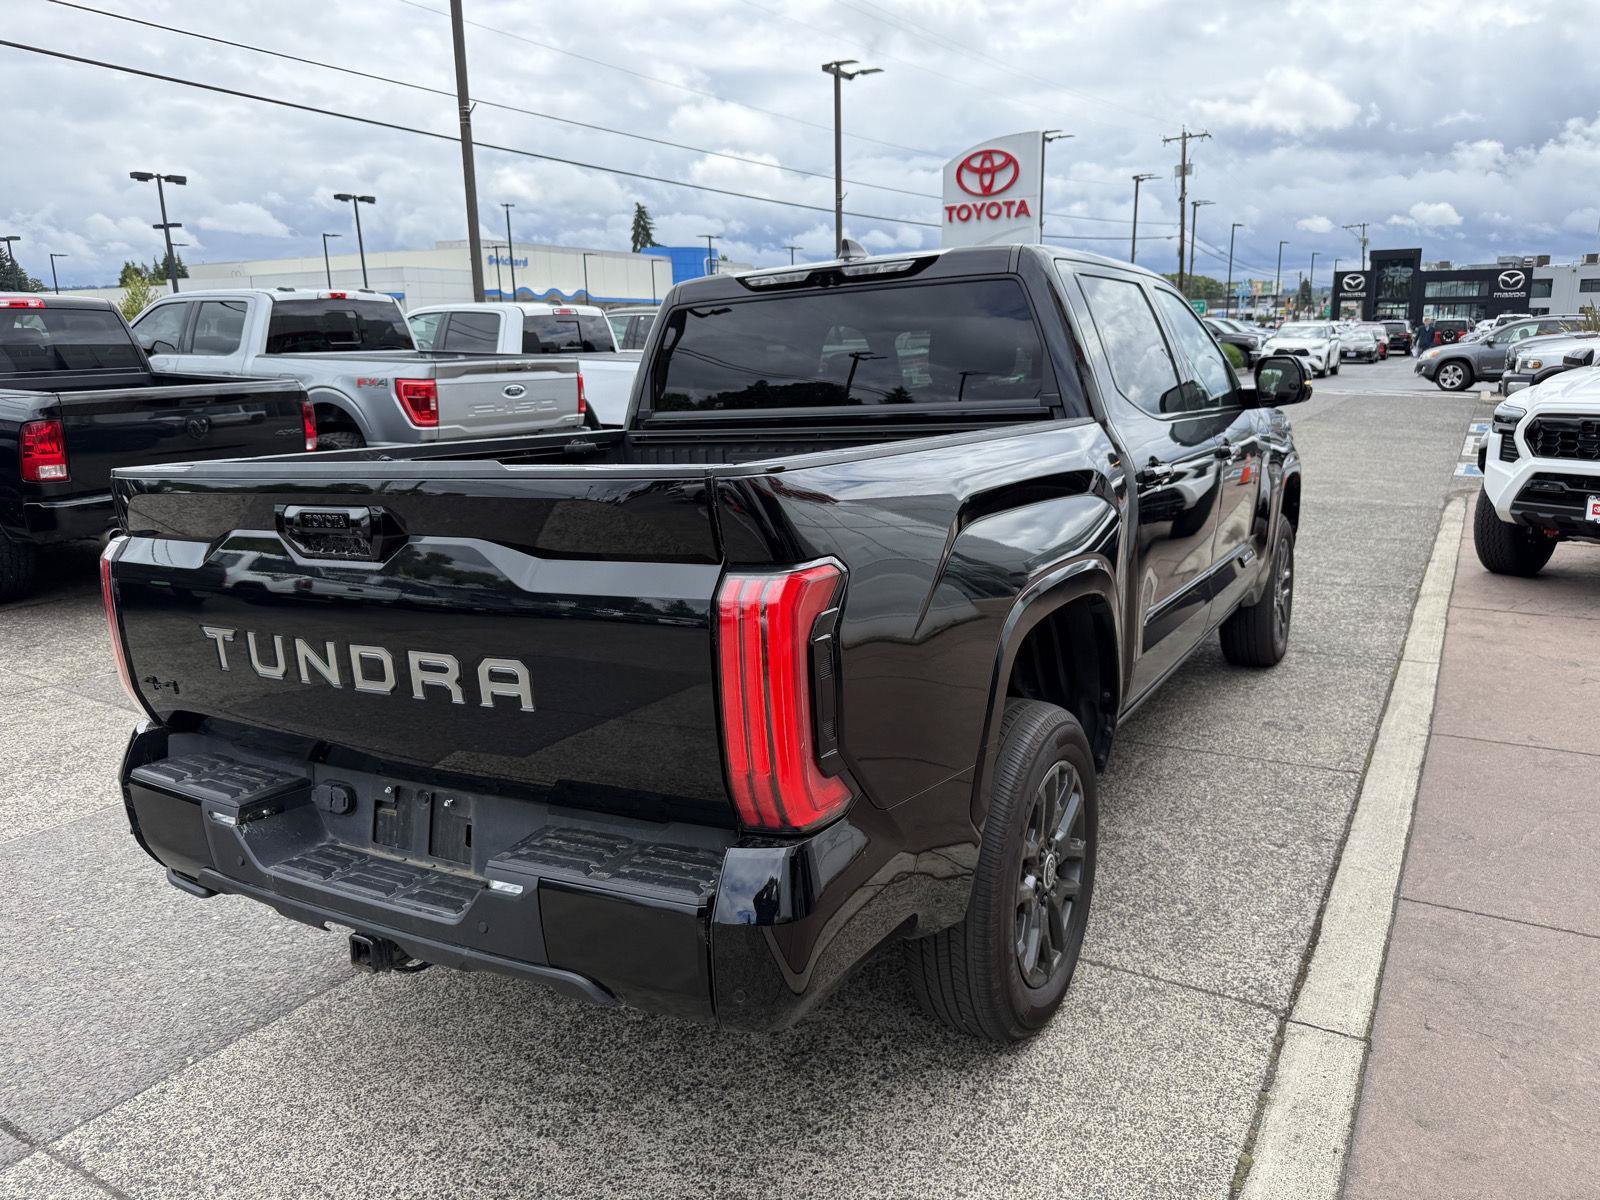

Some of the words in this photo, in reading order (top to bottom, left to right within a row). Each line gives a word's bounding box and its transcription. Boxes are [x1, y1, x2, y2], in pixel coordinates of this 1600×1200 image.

[945, 199, 1031, 223] TOYOTA
[356, 377, 388, 389] FX4
[304, 513, 348, 528] TOYOTA
[201, 625, 535, 712] TUNDRA
